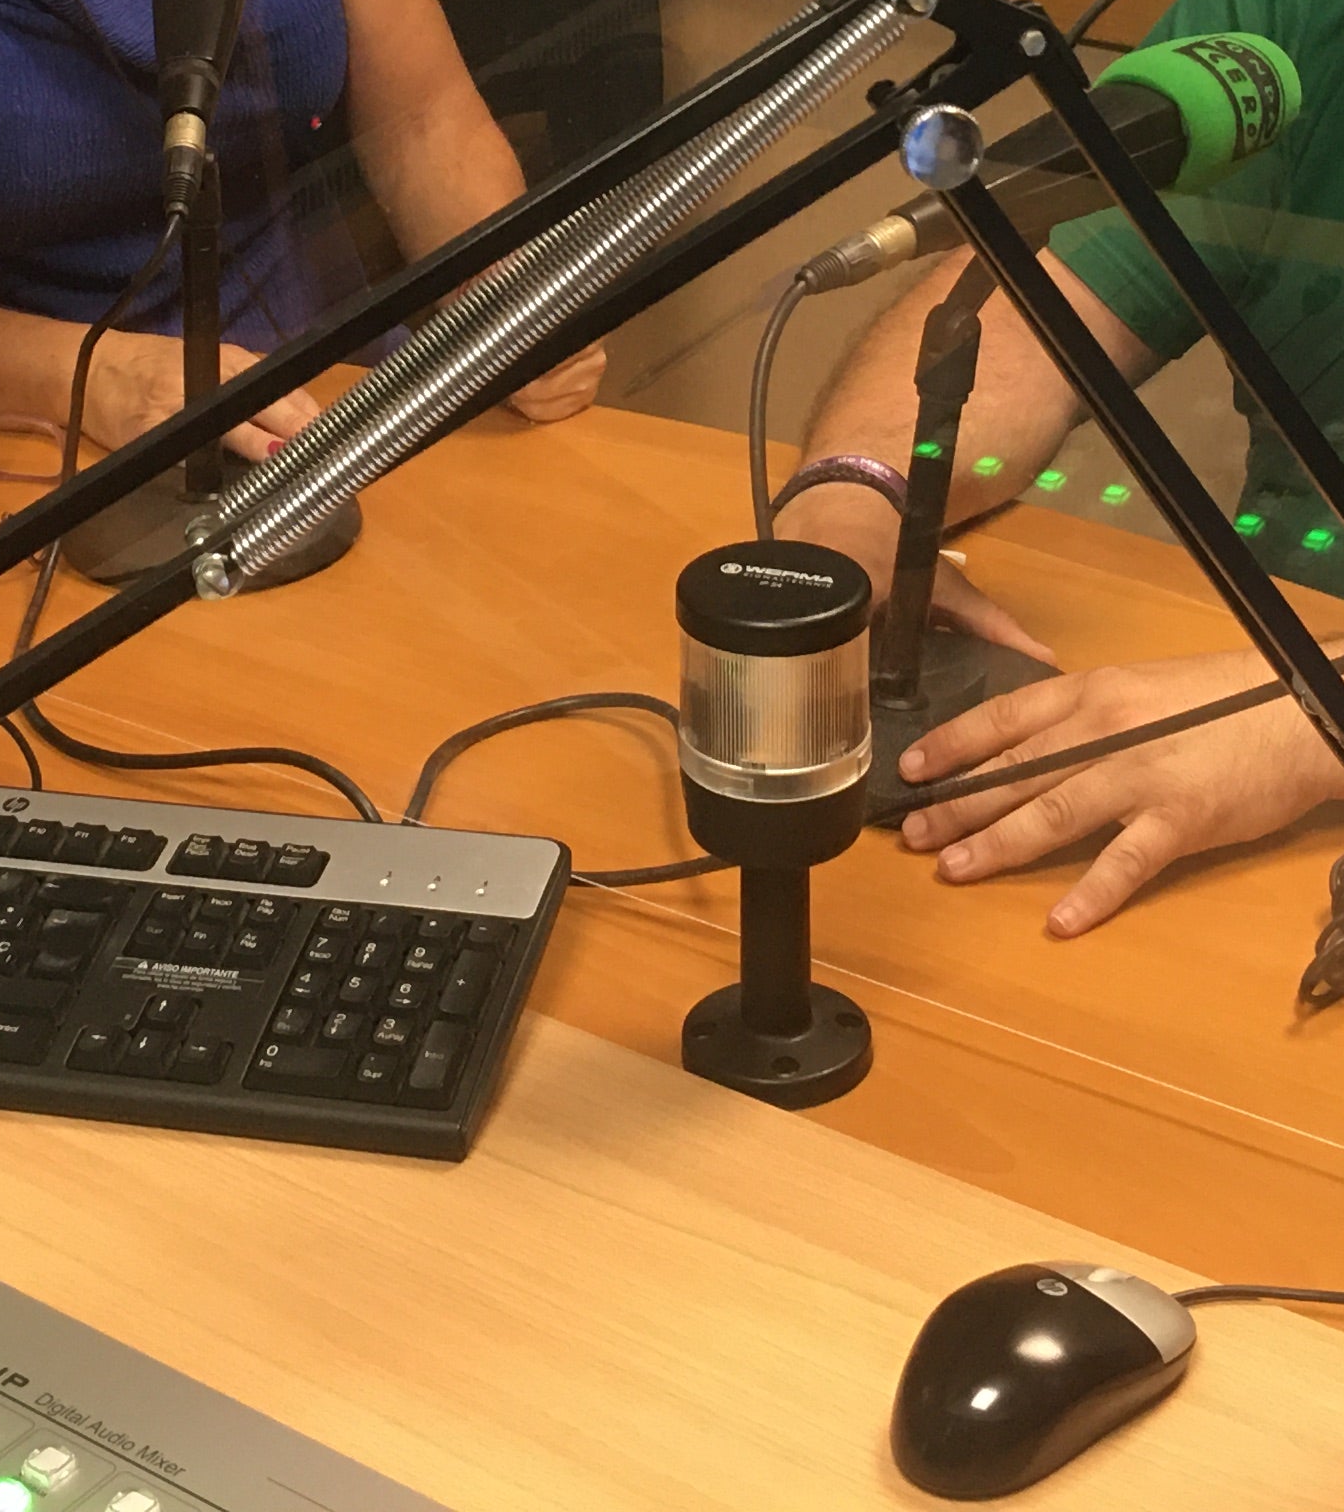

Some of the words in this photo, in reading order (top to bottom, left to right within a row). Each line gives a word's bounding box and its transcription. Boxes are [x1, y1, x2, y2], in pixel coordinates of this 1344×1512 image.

[746, 565, 834, 584] WERMA
[316, 937, 329, 948] 7
[414, 947, 426, 958] 9
[180, 965, 239, 979] IMPORTANTE
[348, 977, 362, 988] 5
[383, 1018, 396, 1029] 3
[34, 1391, 87, 1431] Digital
[85, 1416, 137, 1451] Audio
[137, 1444, 187, 1478] Mixer
